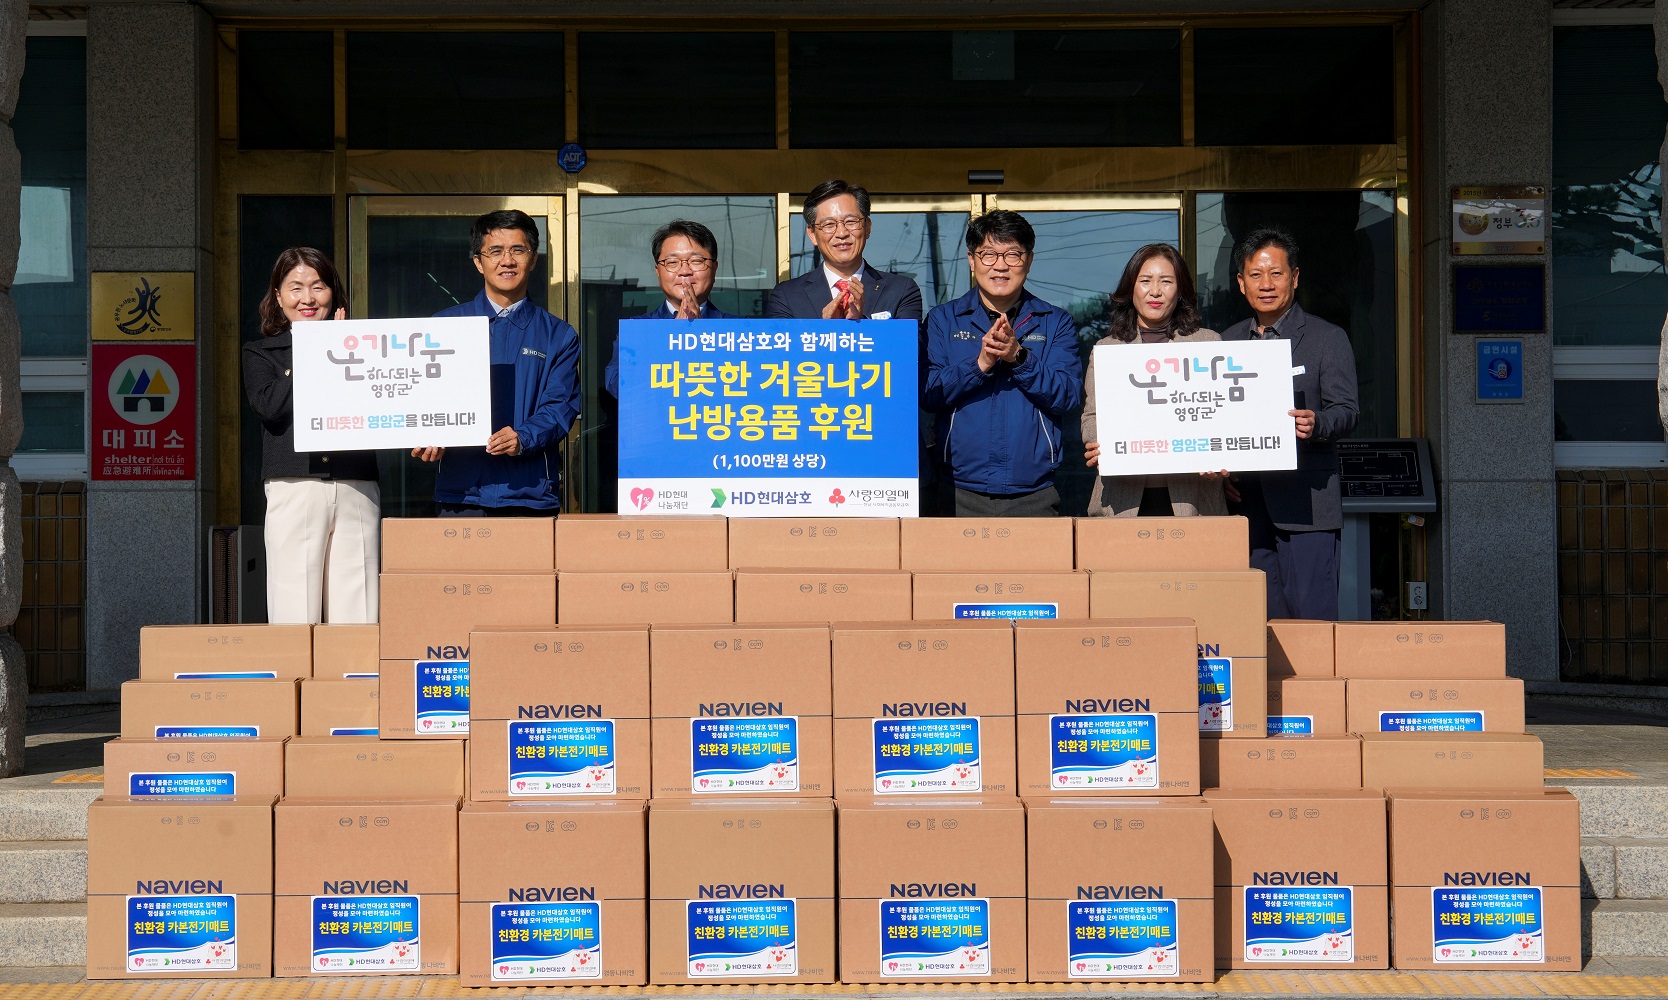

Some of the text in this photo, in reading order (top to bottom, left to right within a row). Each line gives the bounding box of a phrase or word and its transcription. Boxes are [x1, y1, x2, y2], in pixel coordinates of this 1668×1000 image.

[563, 152, 581, 163] ADT
[1493, 217, 1512, 229] 정부
[669, 332, 874, 352] HD현대삼호와 함께하는
[327, 333, 455, 381] 온기나눔
[1483, 346, 1518, 355] 금연시설
[367, 367, 422, 384] 하나되는
[650, 361, 891, 398] 따뜻한 겨울나기
[1129, 356, 1258, 405] 온기나눔
[371, 383, 413, 398] 영암군
[1170, 390, 1226, 408] 하나되는
[311, 412, 476, 431] 더 따뜻한 영암군을 만듭니다!
[668, 403, 873, 441] 난방용품 후원
[1174, 407, 1216, 422] 영암군
[102, 429, 184, 449] 대피소
[1115, 436, 1281, 454] 더 따뜻한 영암군을 만듭니다!
[104, 455, 152, 464] shelter
[713, 454, 826, 470] (1,100만원 상당)
[103, 466, 151, 475] 应急避难所
[658, 490, 688, 499] HD현대
[731, 491, 812, 505] HD현대삼호
[849, 489, 909, 501] 사랑의열매
[658, 501, 688, 510] 나눔재단
[422, 686, 452, 698] 친환경
[515, 744, 608, 758] 친환경 카본전기매트
[698, 741, 791, 756] 친환경 카본전기매트
[880, 742, 973, 757] 친환경 카본전기매트
[1057, 739, 1151, 753] 친환경 카본전기매트
[1251, 911, 1346, 924] 친환경 카본전기매트
[1439, 911, 1536, 925] 친환경 카본전기매트
[134, 919, 229, 934] 친환경 카본전기매트
[318, 920, 413, 935] 친환경 카본전기매트
[694, 924, 789, 939] 친환경 카본전기매트
[887, 924, 982, 938] 친환경 카본전기매트
[1075, 925, 1170, 939] 친환경 카본전기매트
[498, 927, 594, 942] 친환경 카본전기매트
